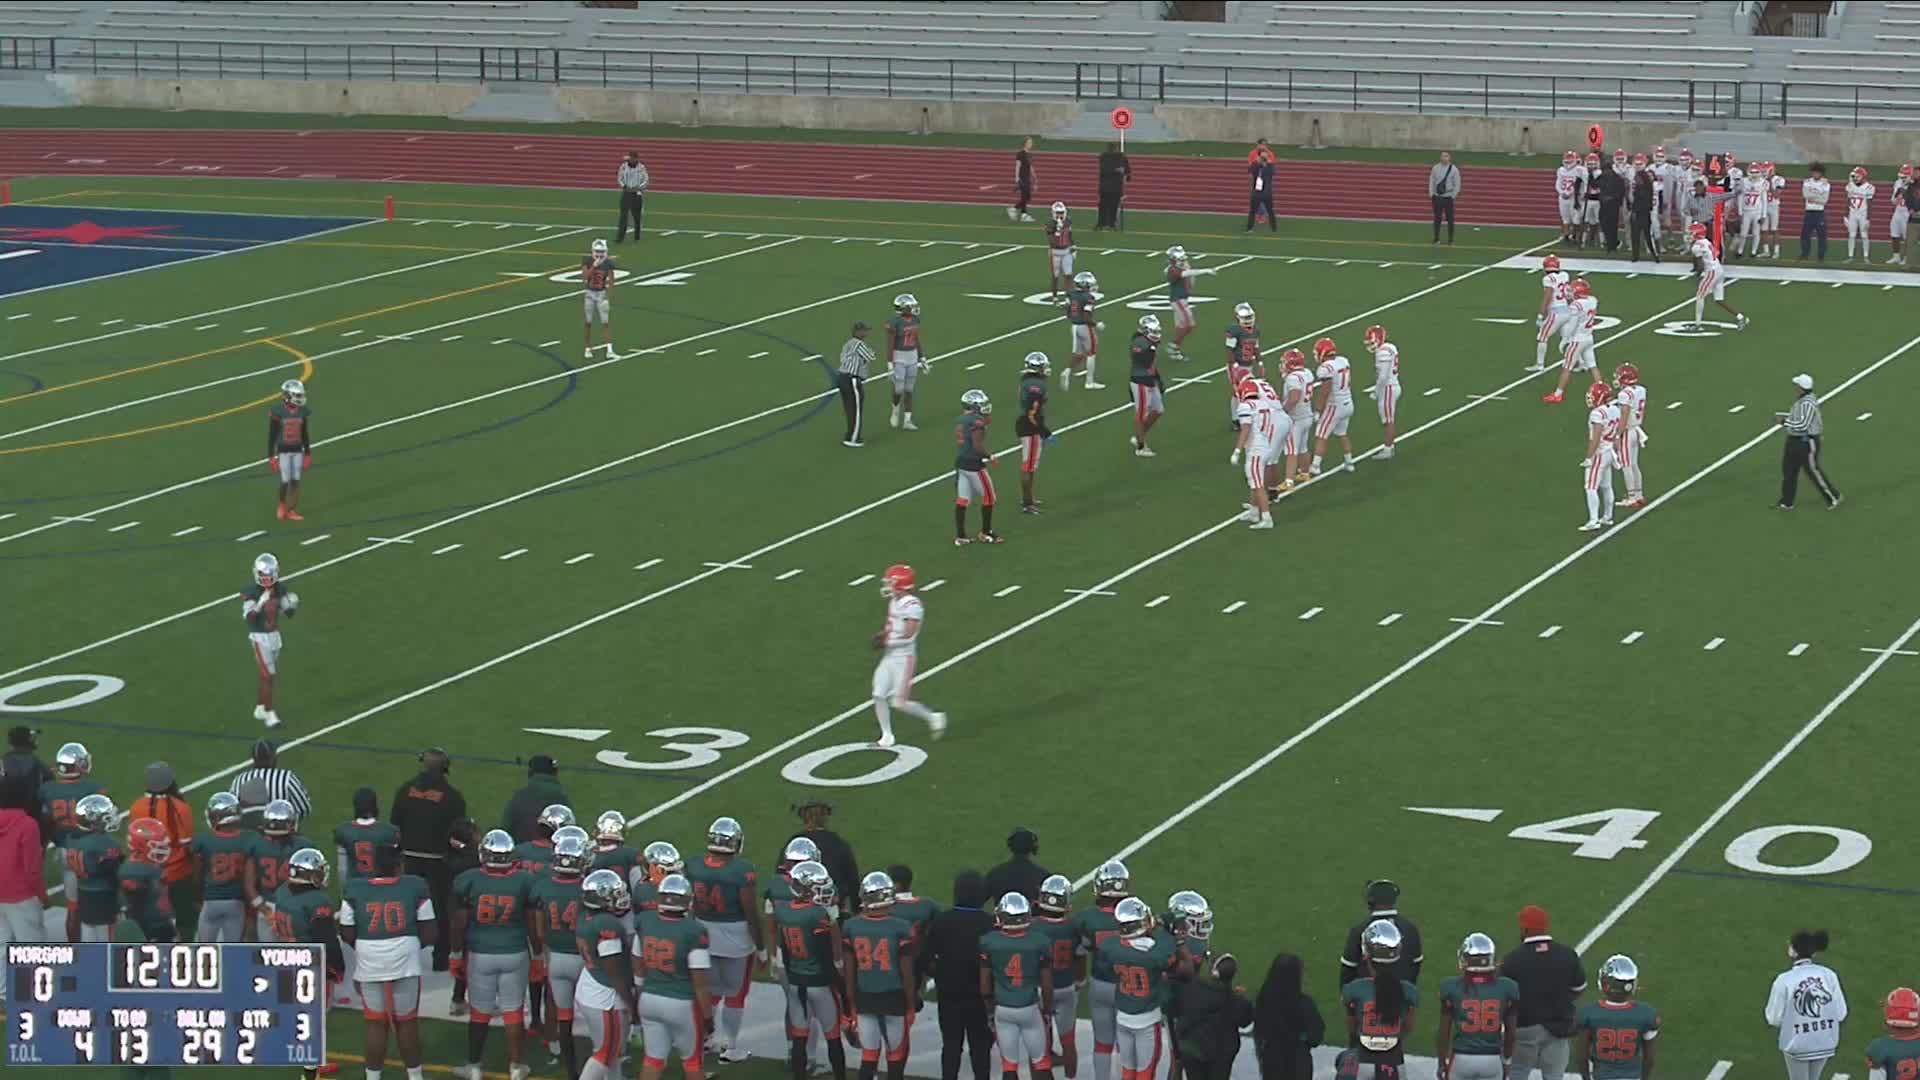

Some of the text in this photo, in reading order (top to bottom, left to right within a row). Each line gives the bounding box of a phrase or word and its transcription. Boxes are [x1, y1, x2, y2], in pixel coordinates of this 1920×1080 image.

[1708, 156, 1721, 175] 4
[355, 841, 375, 872] 5
[366, 901, 406, 933] 70
[477, 895, 514, 926] 67
[1004, 953, 1023, 987] 4
[1793, 1019, 1835, 1035] TRUST
